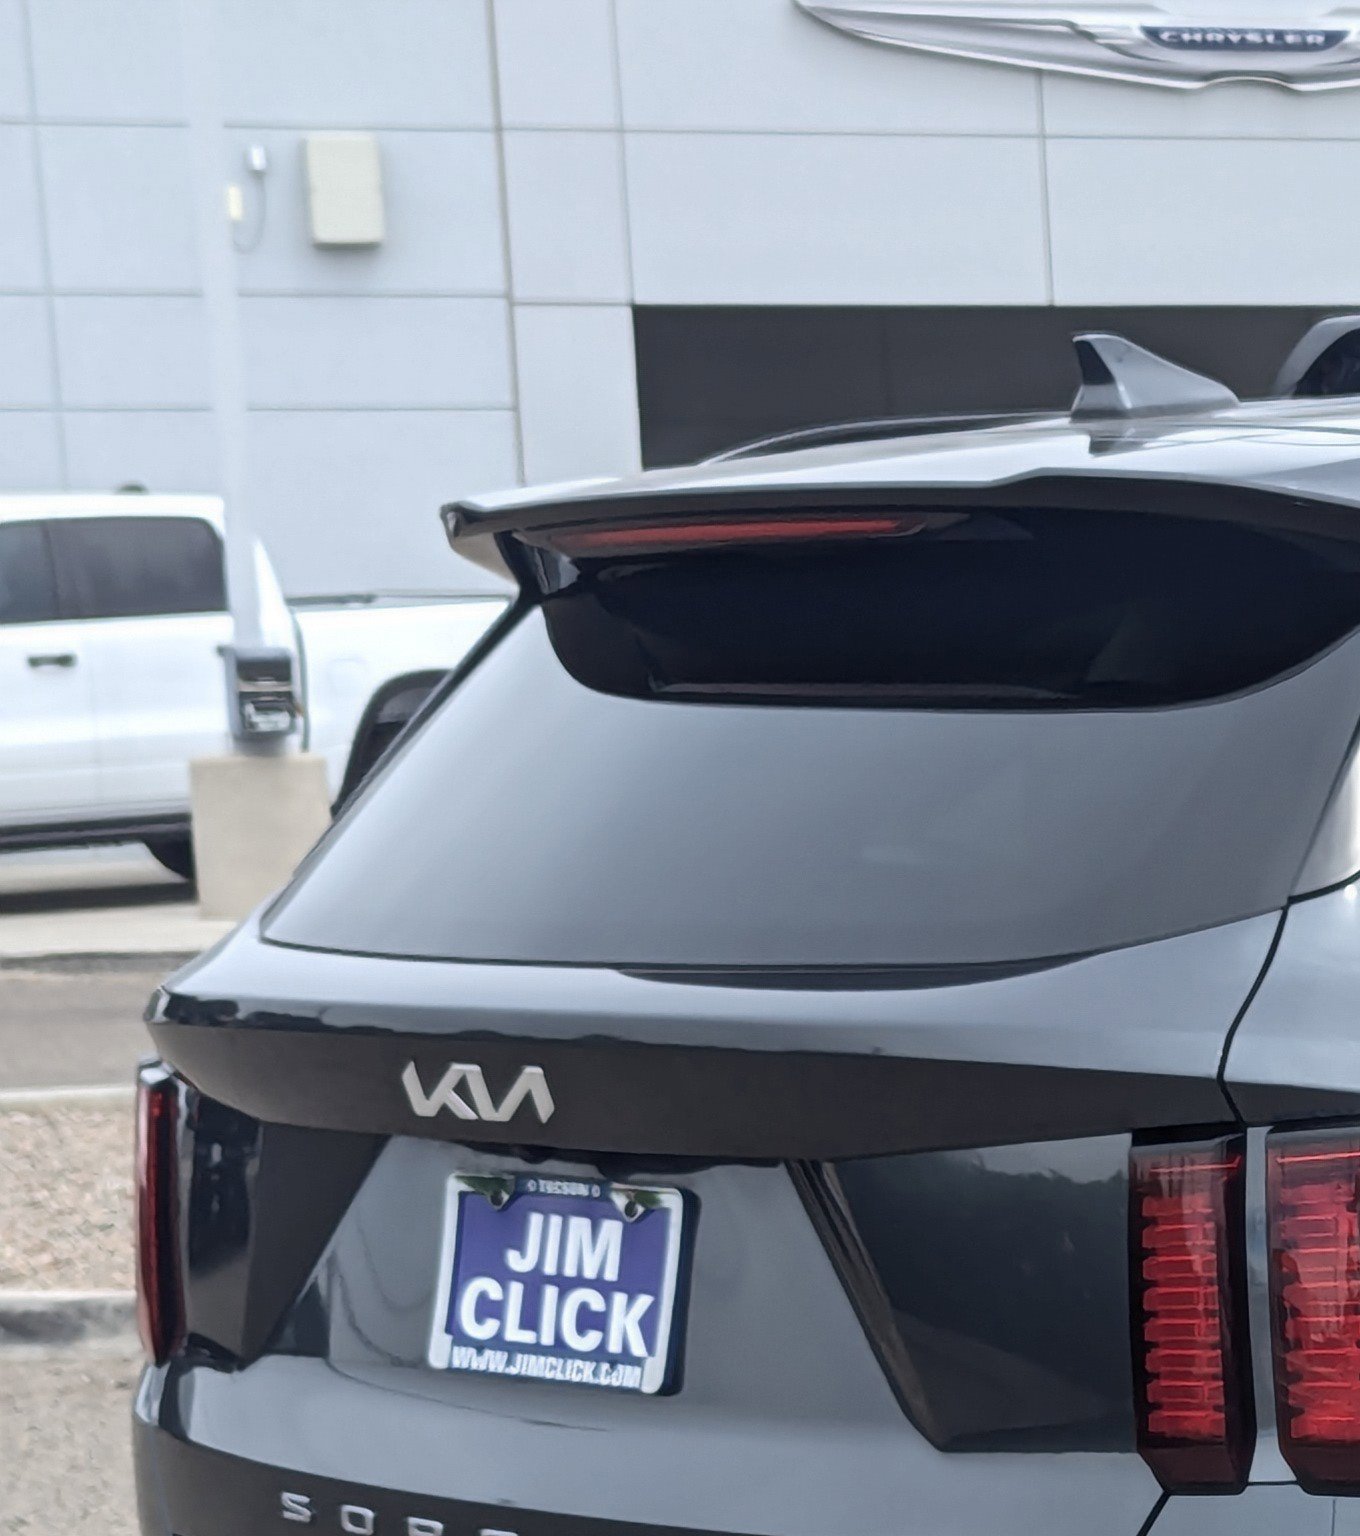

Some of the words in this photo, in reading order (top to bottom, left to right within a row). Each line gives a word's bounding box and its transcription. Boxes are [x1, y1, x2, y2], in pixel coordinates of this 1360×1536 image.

[1157, 29, 1327, 46] CHRYSLER
[402, 1060, 555, 1124] KIA
[504, 1211, 624, 1282] JIM
[459, 1276, 655, 1357] CLICK
[451, 1345, 642, 1389] WWW.JIMCLICK.COM
